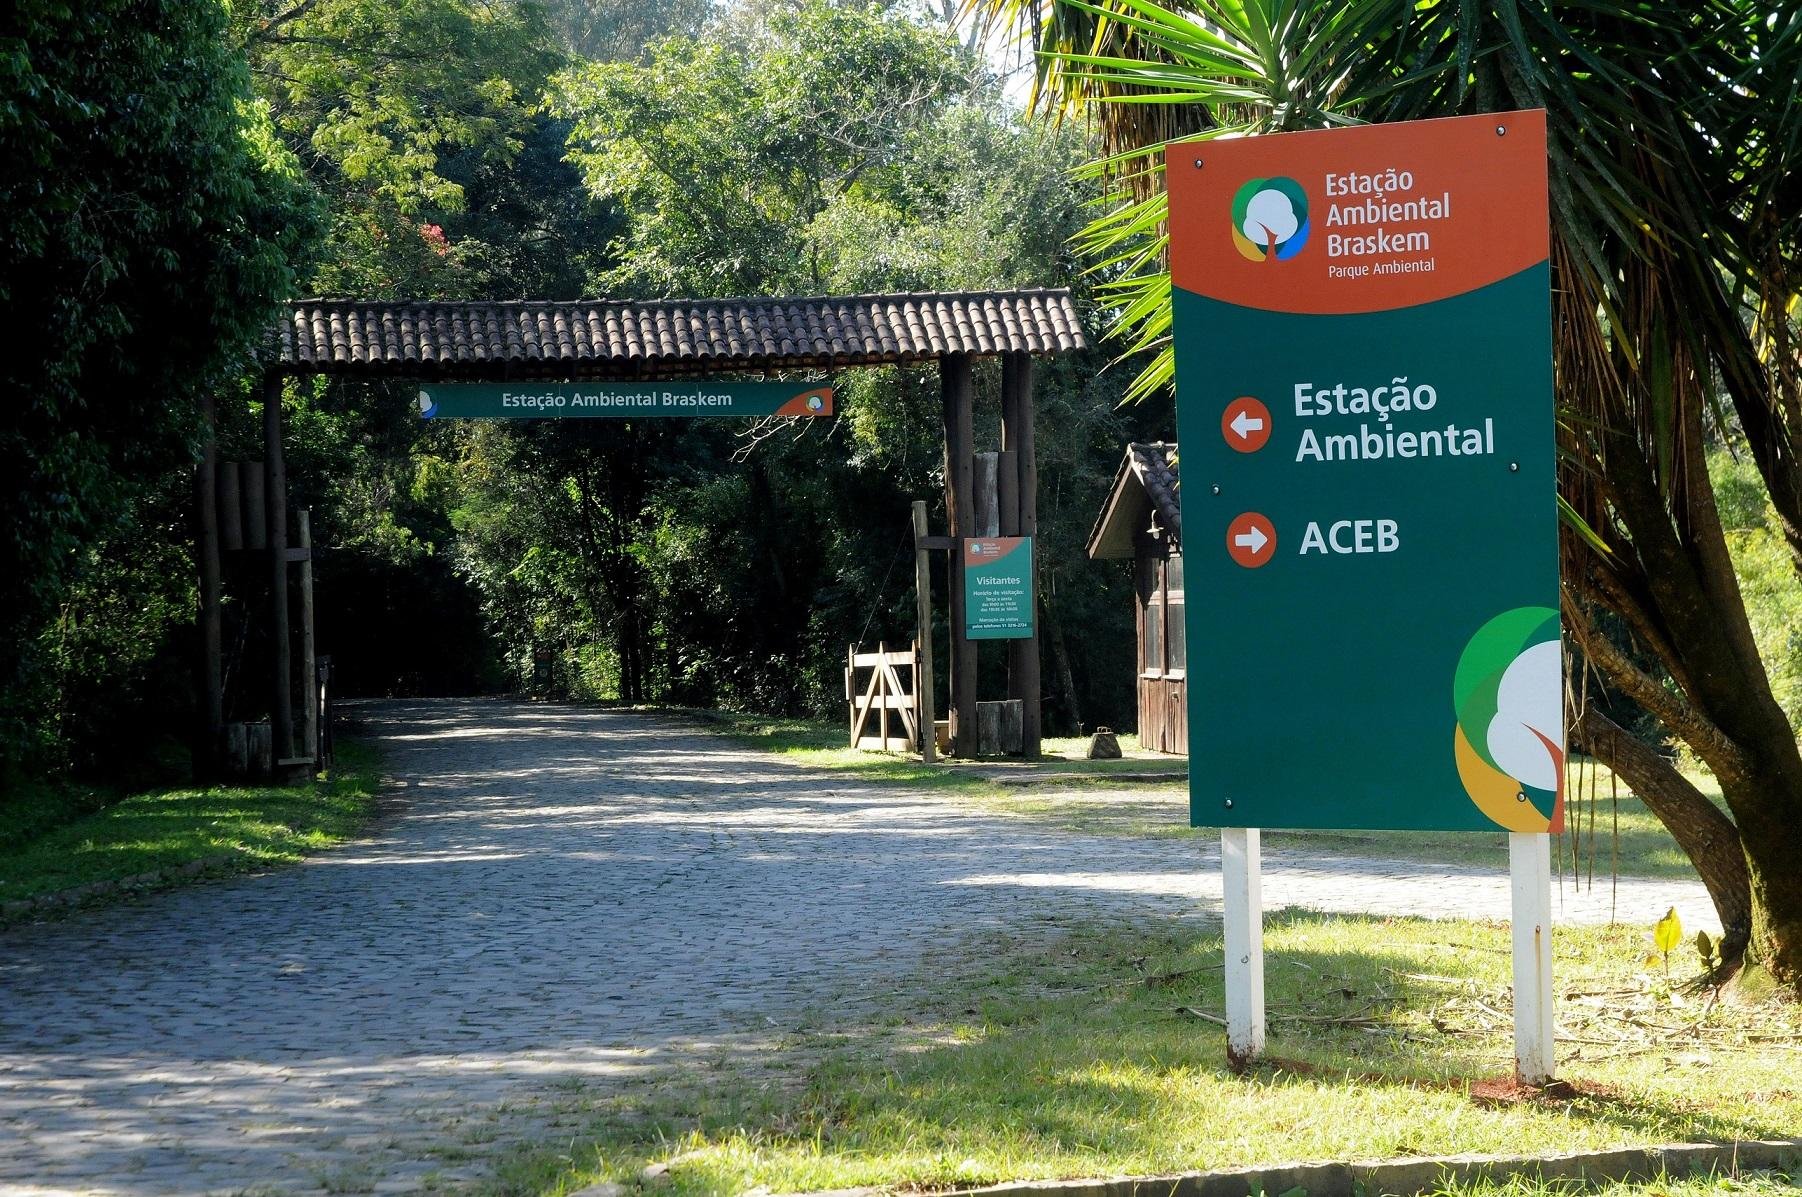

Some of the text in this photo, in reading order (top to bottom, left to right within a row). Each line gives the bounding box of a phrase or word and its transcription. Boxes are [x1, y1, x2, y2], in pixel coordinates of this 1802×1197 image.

[1326, 169, 1413, 198] Estação
[1326, 193, 1450, 227] Ambiental
[1327, 228, 1430, 257] Braskem
[1328, 258, 1435, 279] Parque Ambiental
[502, 391, 732, 411] Estação Ambiental Braskem
[1294, 376, 1437, 422] Estação
[1295, 418, 1494, 462] Ambiental
[1299, 519, 1400, 555] ACEB
[976, 576, 1021, 585] Visitantes
